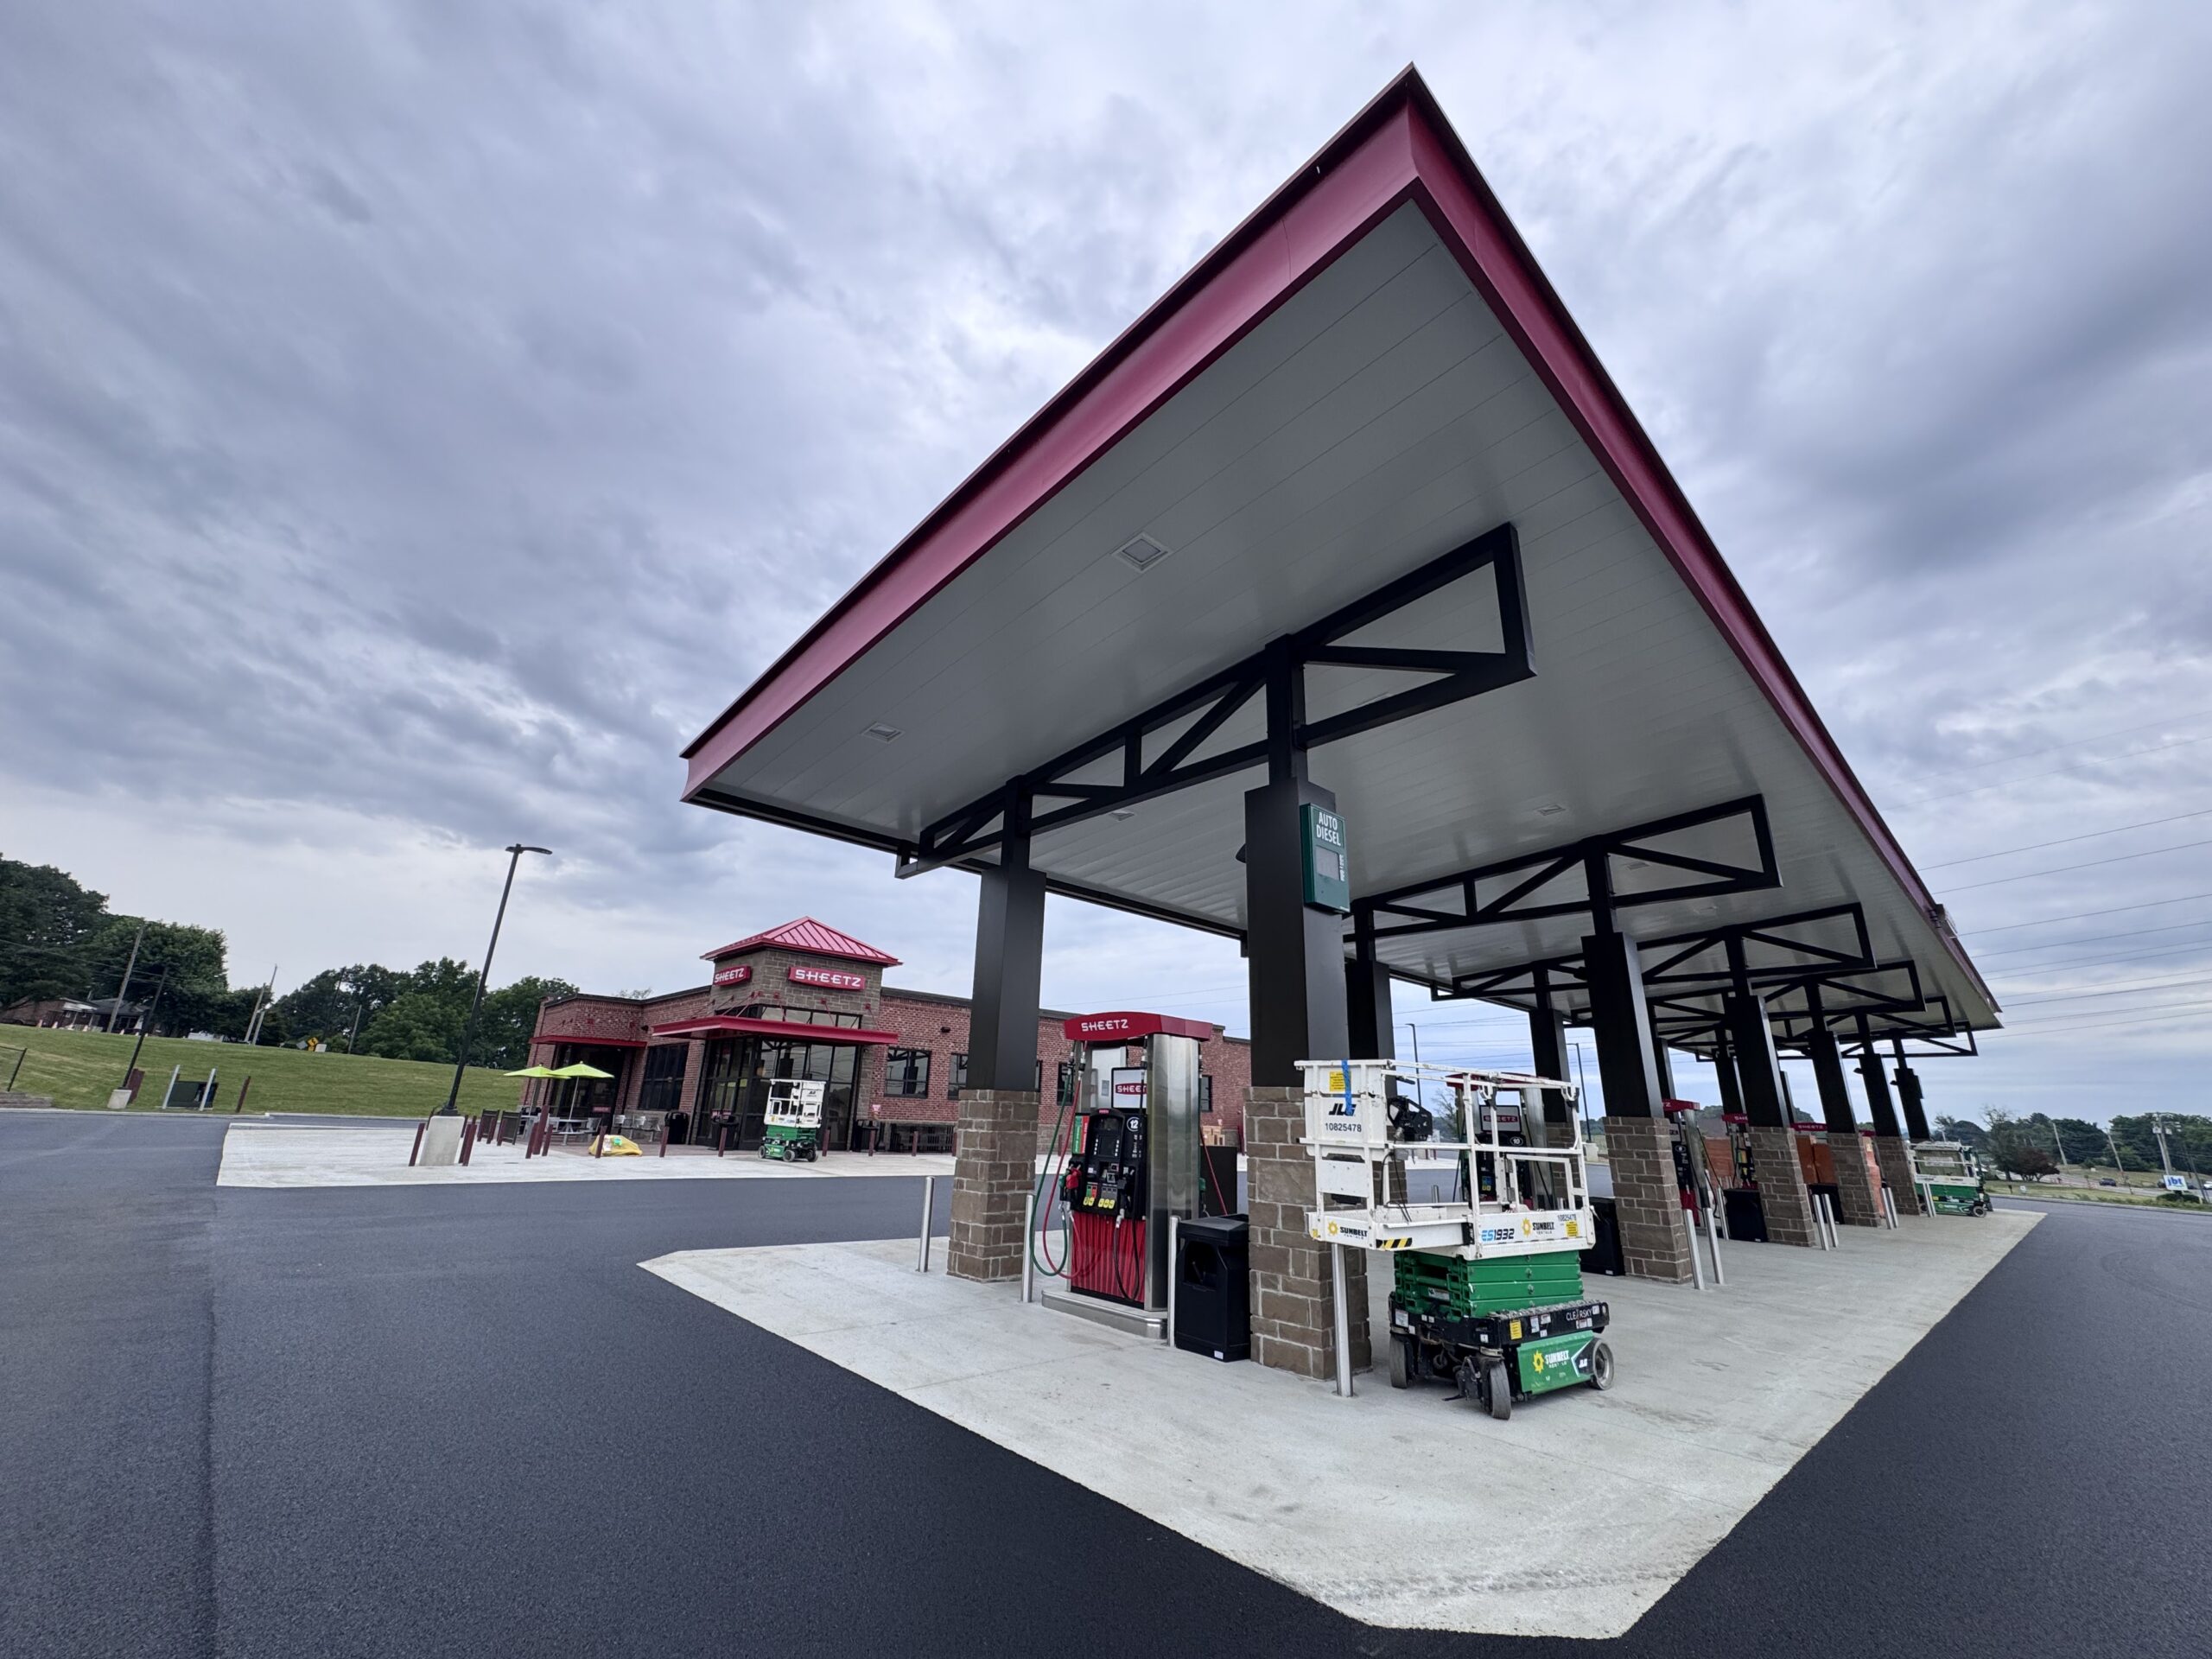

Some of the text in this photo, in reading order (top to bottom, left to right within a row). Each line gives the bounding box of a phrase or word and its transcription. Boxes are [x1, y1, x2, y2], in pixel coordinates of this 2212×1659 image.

[1318, 811, 1338, 831] AUTO
[1316, 823, 1342, 847] DIESEL
[714, 967, 745, 983] SHEETZ
[795, 969, 861, 988] SHEETZ
[1081, 1019, 1129, 1032] SHEETZ
[1129, 1119, 1139, 1129] 12
[1325, 1122, 1363, 1133] 10825478
[1339, 1226, 1369, 1237] SUNBELT
[1532, 1222, 1555, 1231] SUNBELT
[1481, 1228, 1515, 1242] ES1932
[1544, 1350, 1570, 1364] SUNBELT
